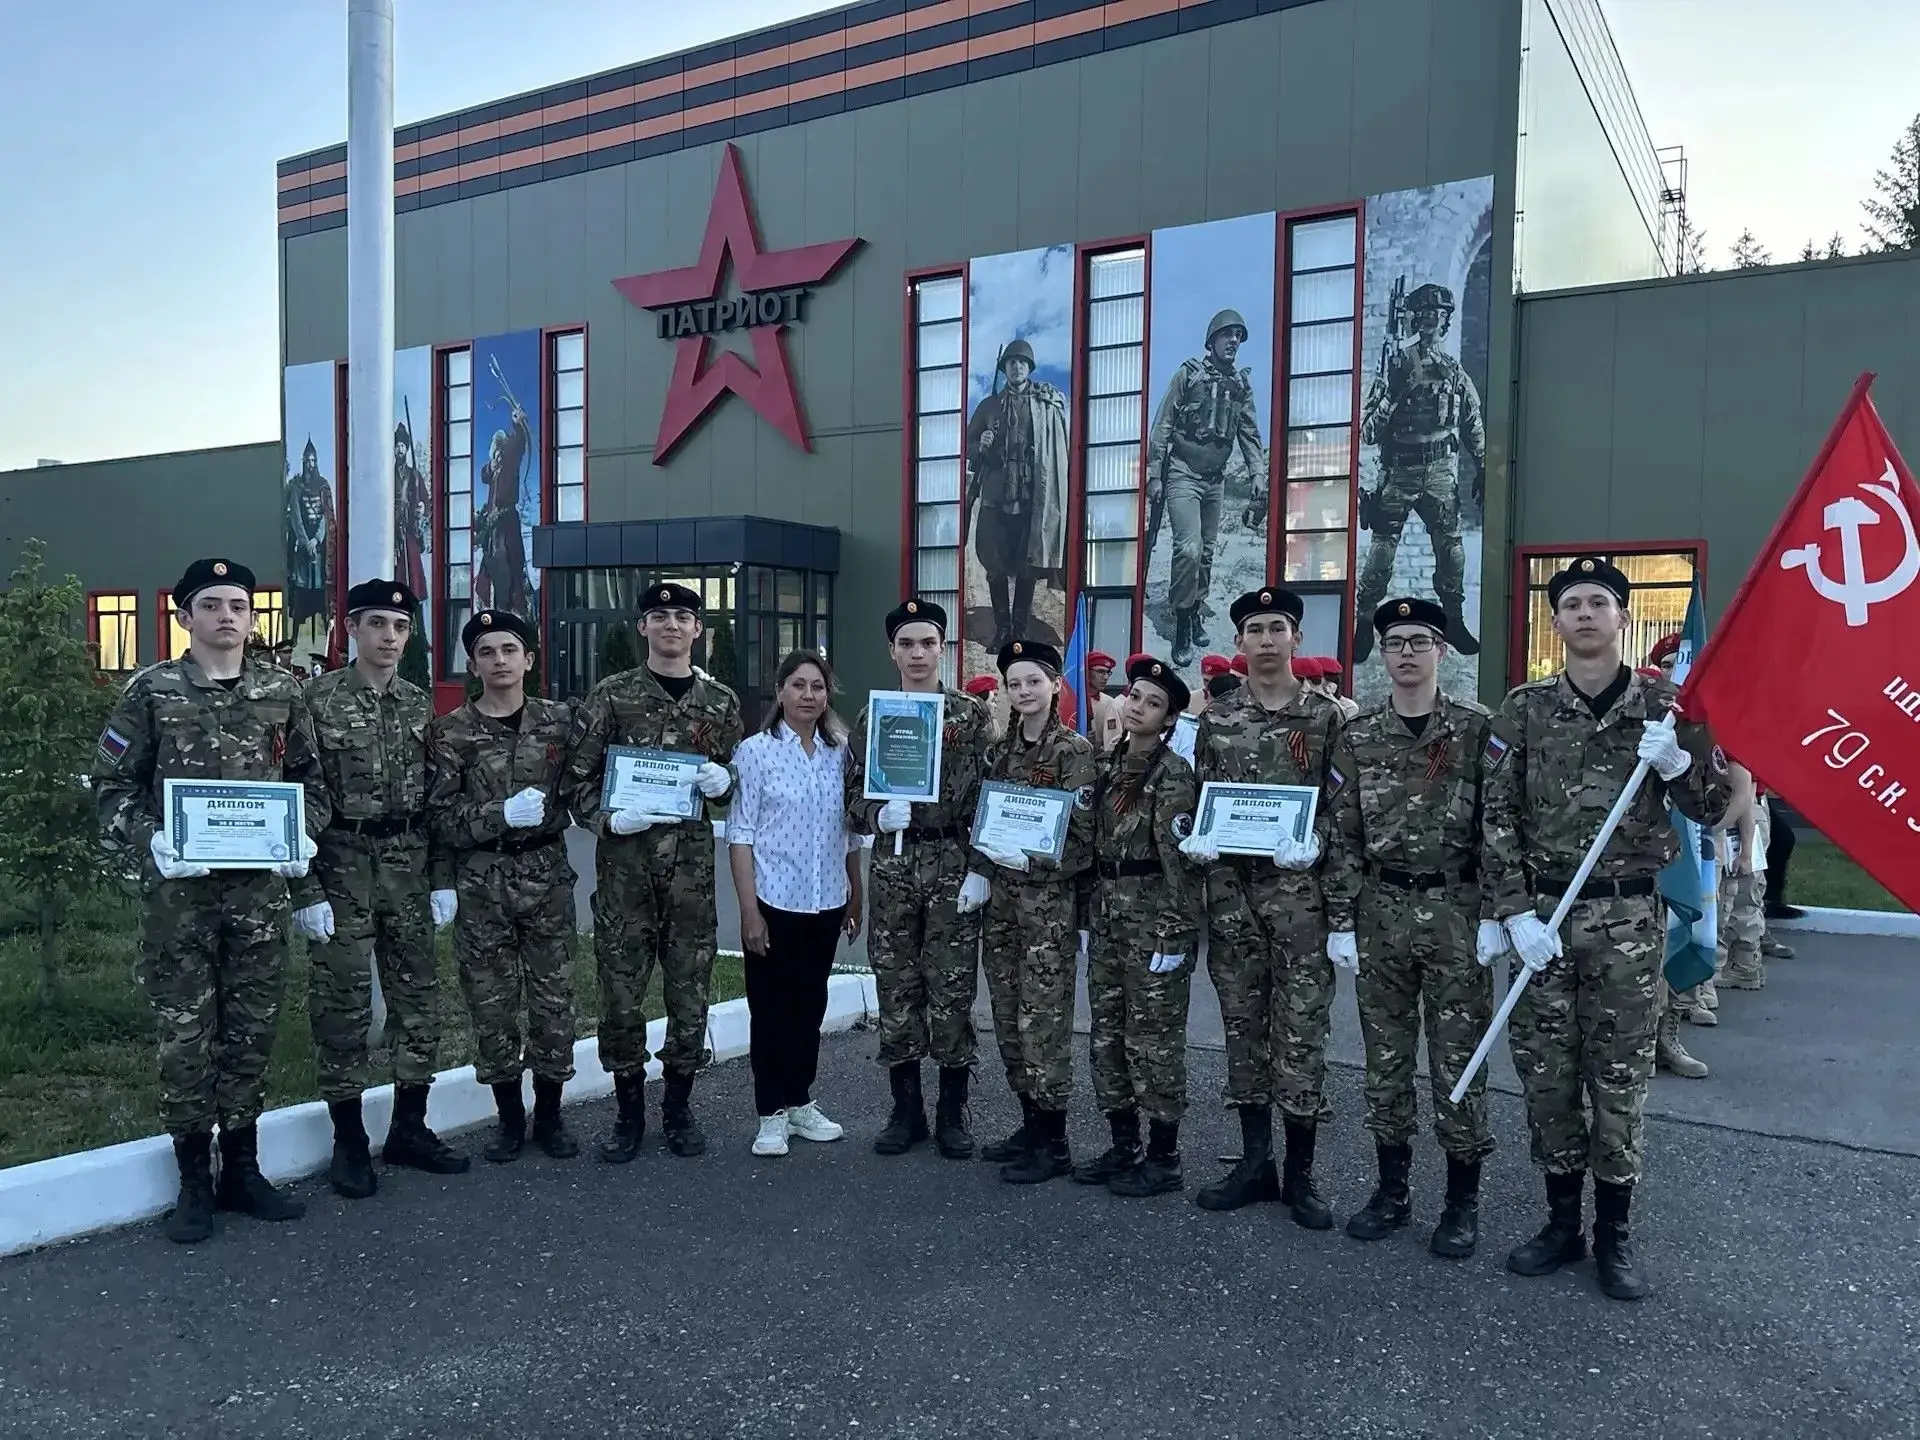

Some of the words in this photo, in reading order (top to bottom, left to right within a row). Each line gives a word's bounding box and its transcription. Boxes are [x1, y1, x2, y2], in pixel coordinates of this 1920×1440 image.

[656, 287, 806, 338] ПАТРИОТ
[1800, 708, 1871, 769] 79
[634, 760, 680, 772] ДИПЛОМ
[207, 799, 265, 809] ДИПЛОМ
[1003, 795, 1047, 807] ДИПЛОМ
[1232, 799, 1282, 808] ДИПЛОМ
